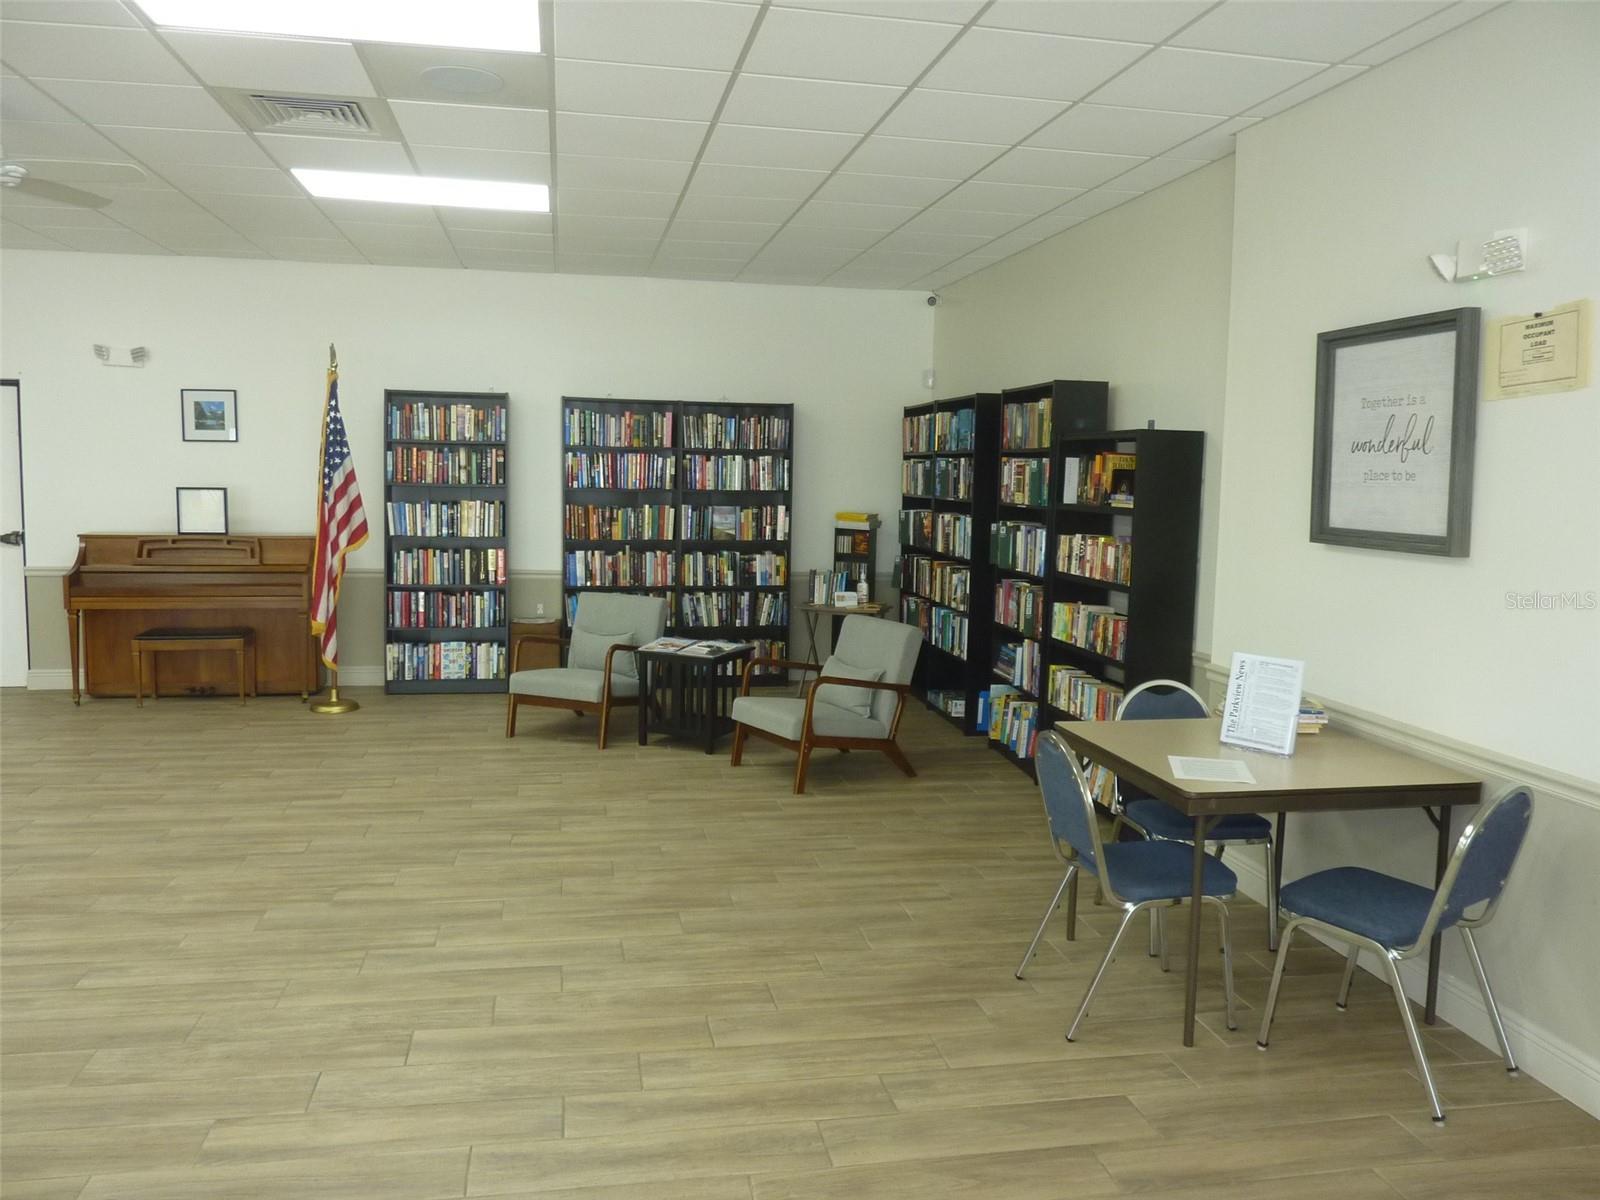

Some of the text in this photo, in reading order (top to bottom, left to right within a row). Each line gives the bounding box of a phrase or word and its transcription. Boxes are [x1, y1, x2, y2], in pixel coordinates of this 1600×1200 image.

[1523, 329, 1555, 339] OCCUPANT
[1361, 394, 1427, 411] Together is a
[1351, 413, 1434, 463] wonderful
[1363, 469, 1417, 483] place to be
[1227, 659, 1247, 733] The Parkview News
